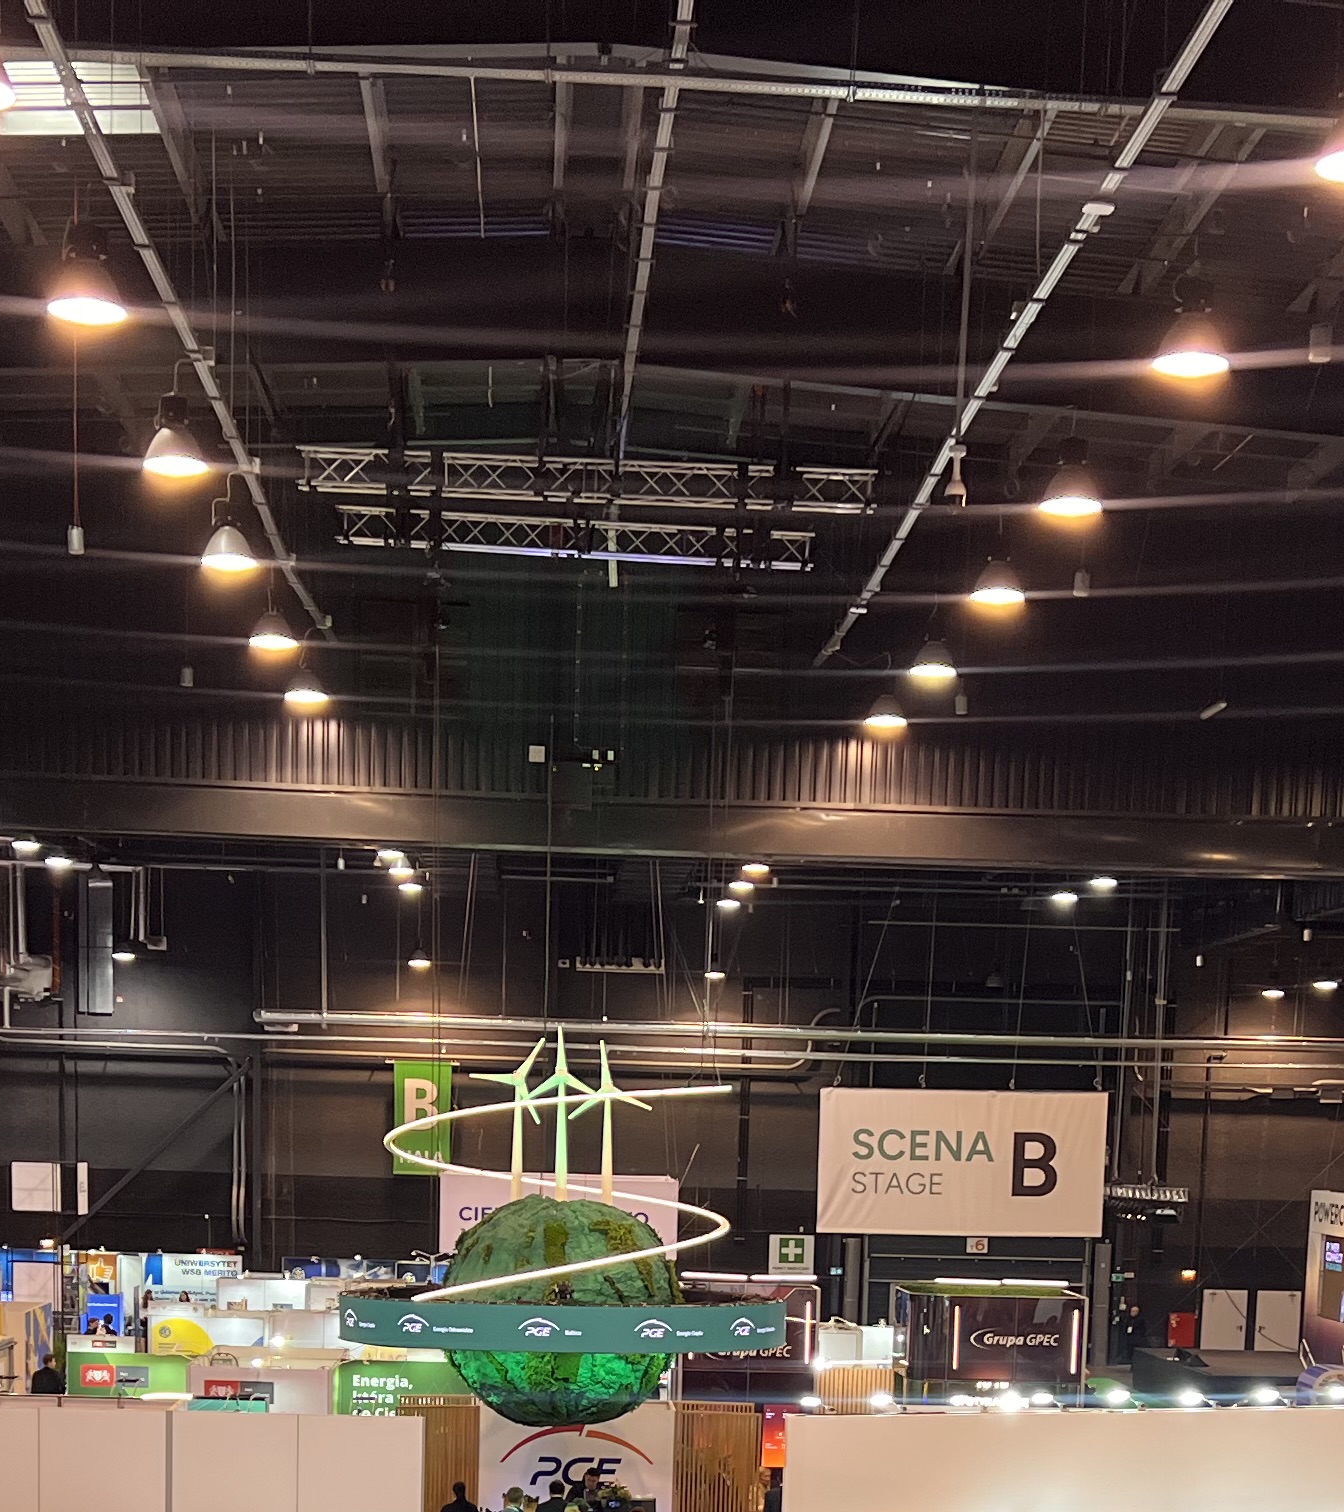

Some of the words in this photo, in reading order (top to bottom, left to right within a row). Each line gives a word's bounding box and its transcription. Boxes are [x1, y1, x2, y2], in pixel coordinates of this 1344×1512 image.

[404, 1078, 439, 1130] B
[852, 1128, 994, 1162] SCENA
[1012, 1132, 1057, 1197] B
[851, 1172, 943, 1195] STAGE
[402, 1323, 422, 1333] PGE
[525, 1327, 552, 1337] PGE
[641, 1328, 664, 1338] PGE
[983, 1333, 1024, 1347] Grupa
[1027, 1334, 1060, 1347] GPEC
[352, 1374, 413, 1390] Energia,
